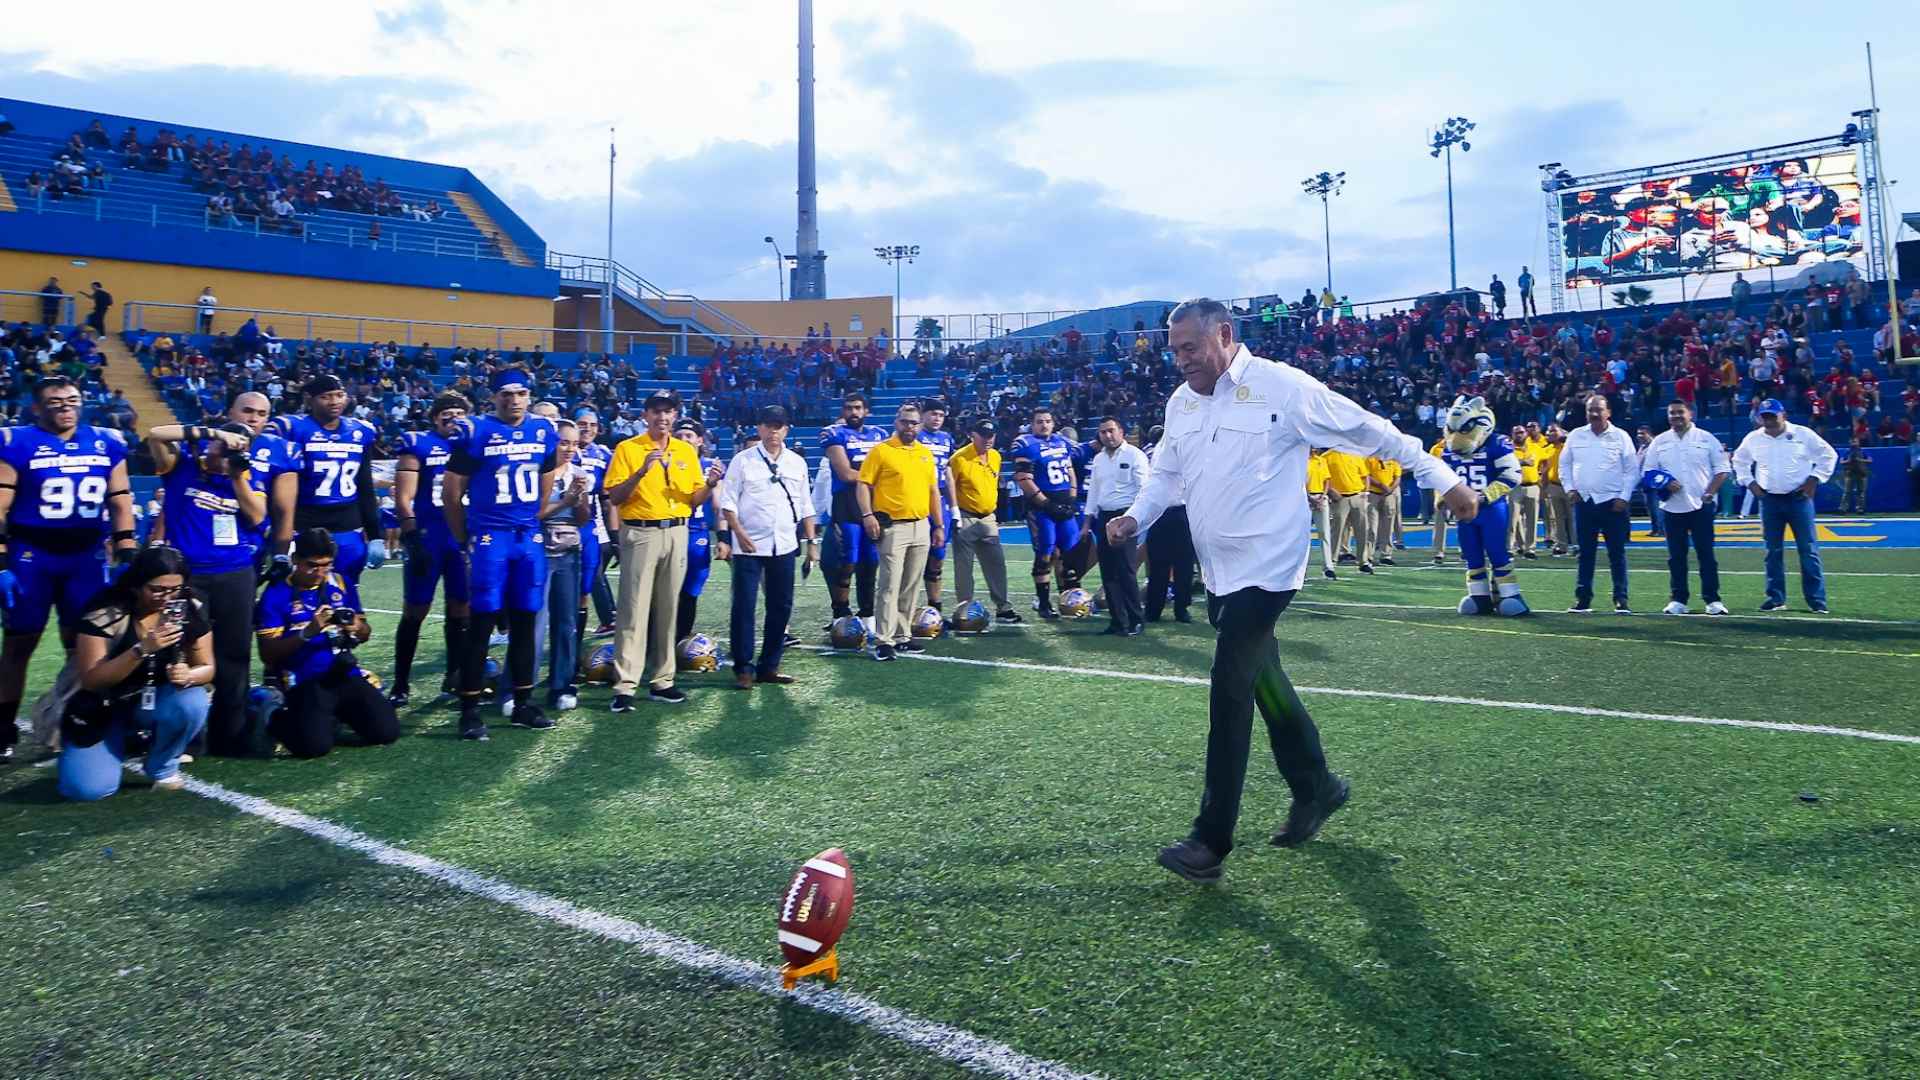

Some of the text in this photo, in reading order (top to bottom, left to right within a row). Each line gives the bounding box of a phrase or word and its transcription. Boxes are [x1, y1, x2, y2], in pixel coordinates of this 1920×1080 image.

[39, 476, 107, 519] 99
[313, 460, 361, 497] 78
[495, 464, 540, 504] 10
